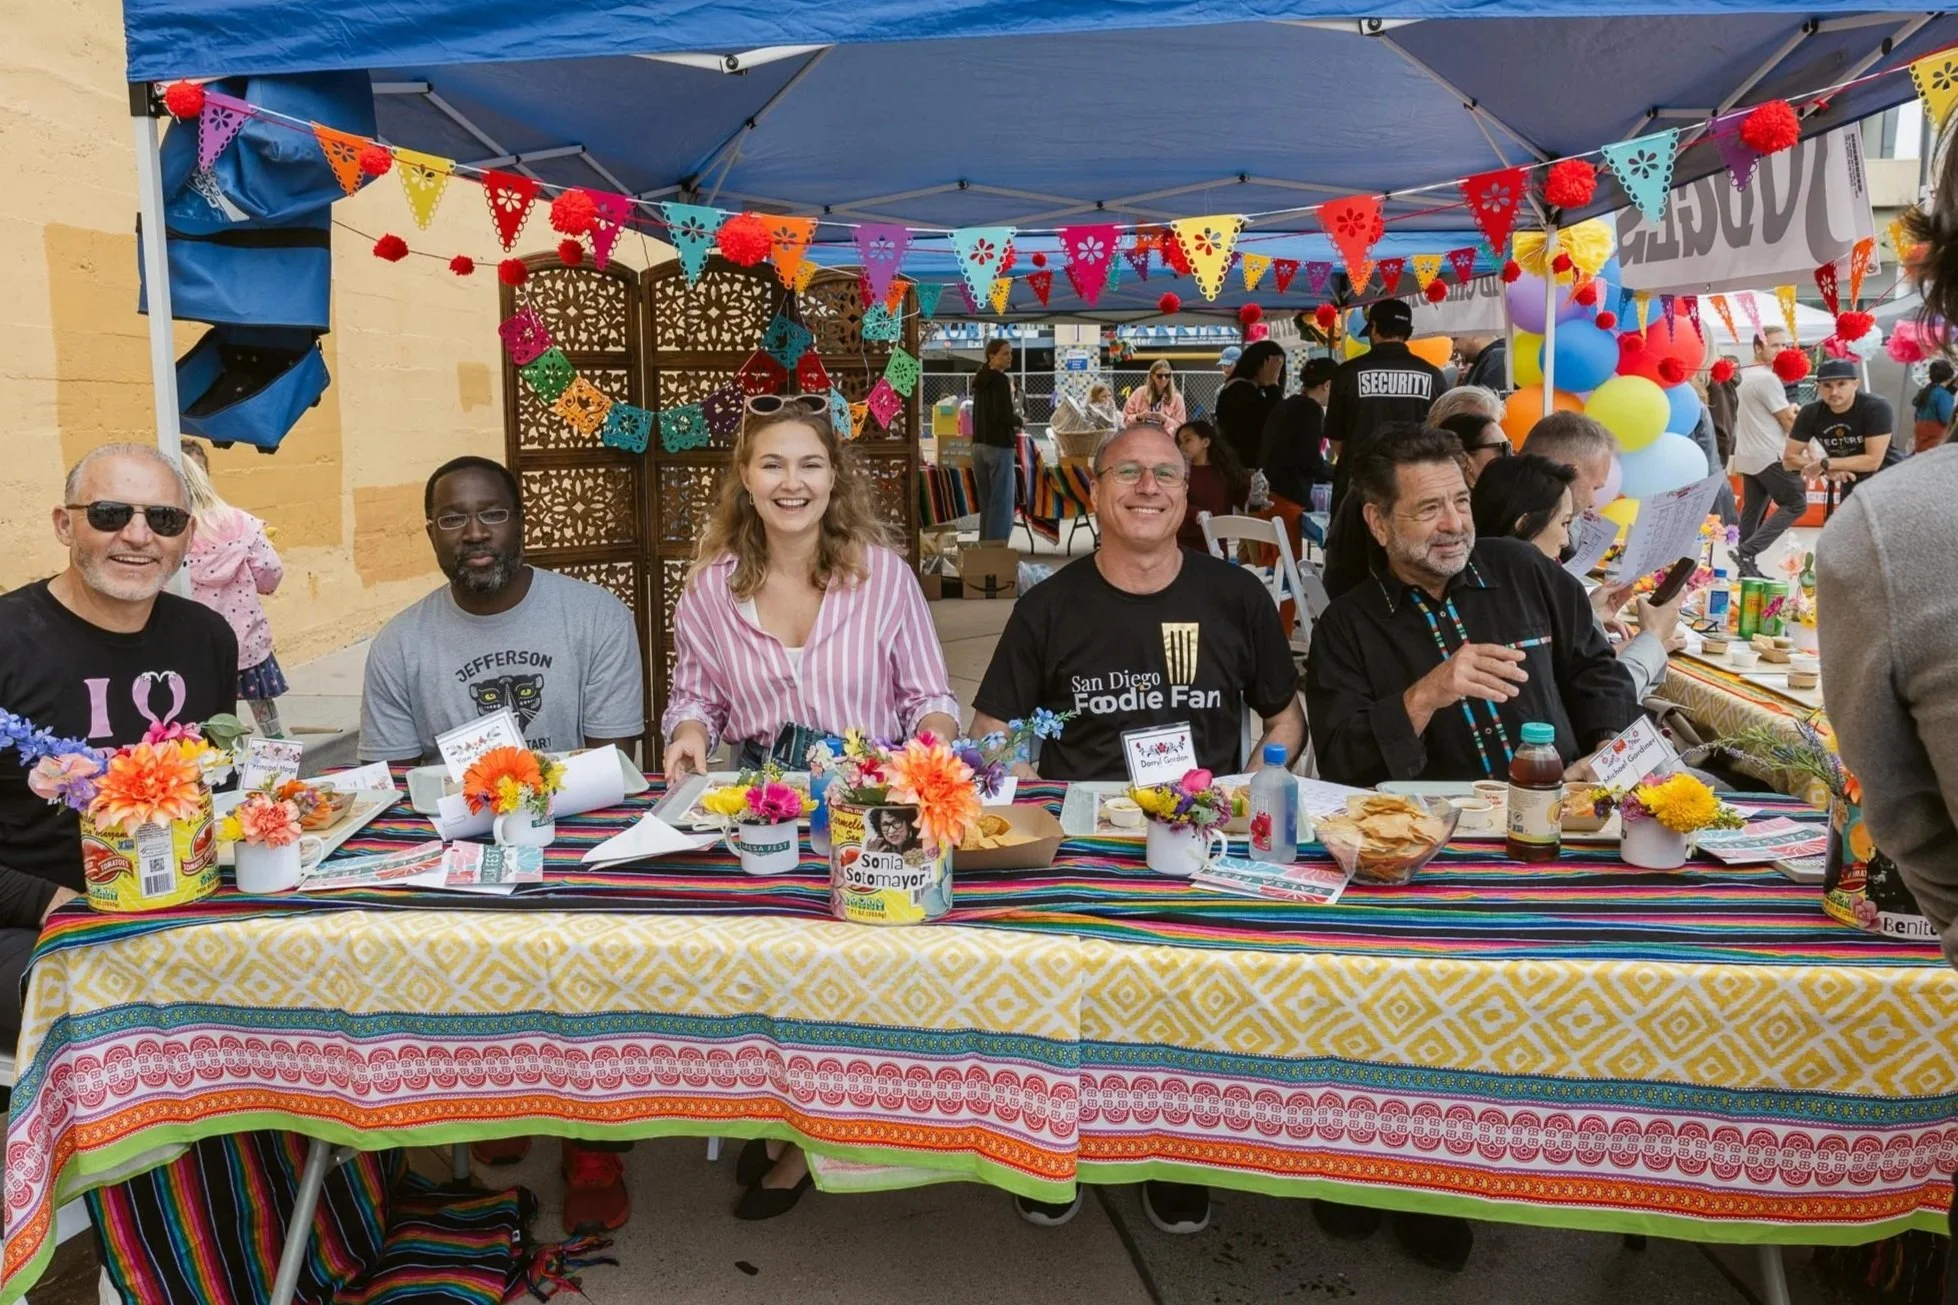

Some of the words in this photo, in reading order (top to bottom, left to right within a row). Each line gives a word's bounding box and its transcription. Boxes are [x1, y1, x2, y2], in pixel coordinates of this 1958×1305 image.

[1361, 372, 1430, 399] SECURITY
[455, 650, 553, 683] JEFFERSON
[1071, 675, 1103, 693] San
[1108, 669, 1161, 690] Diego
[84, 678, 114, 738] I
[1074, 684, 1163, 715] Foodie
[1171, 685, 1221, 709] Fan
[525, 736, 552, 750] TARY
[1603, 761, 1628, 785] Michael
[861, 853, 904, 871] Sonia
[846, 867, 926, 890] Sotomayor
